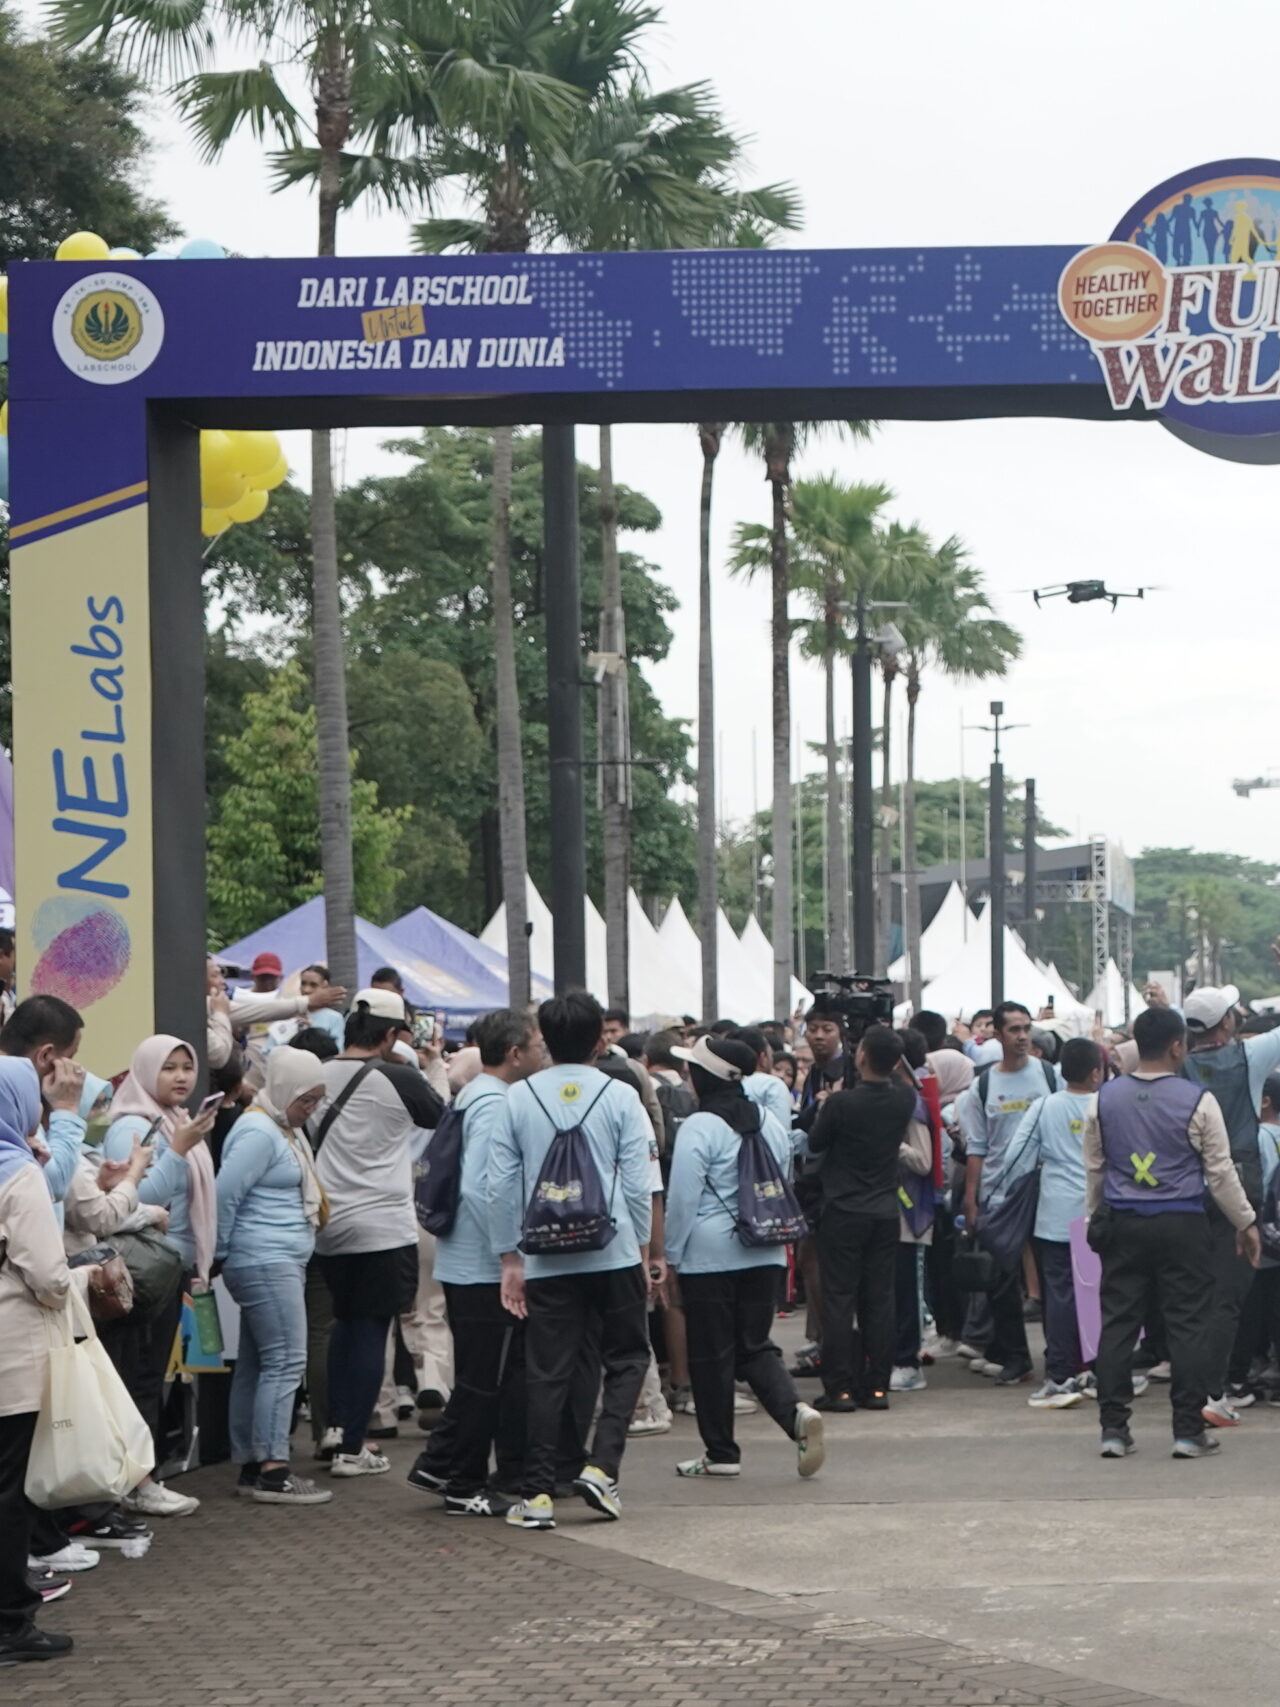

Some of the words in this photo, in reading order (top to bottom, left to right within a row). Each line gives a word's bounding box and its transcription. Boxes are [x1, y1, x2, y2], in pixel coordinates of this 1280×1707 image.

[297, 276, 367, 308] DARI
[372, 274, 534, 307] LABSCHOOL
[1075, 270, 1151, 296] HEALTHY
[1072, 294, 1158, 319] TOGETHER
[252, 339, 403, 371] INDONESIA
[411, 338, 472, 368] DAN
[477, 337, 566, 367] DUNIA
[76, 363, 138, 373] LABSCHOOL
